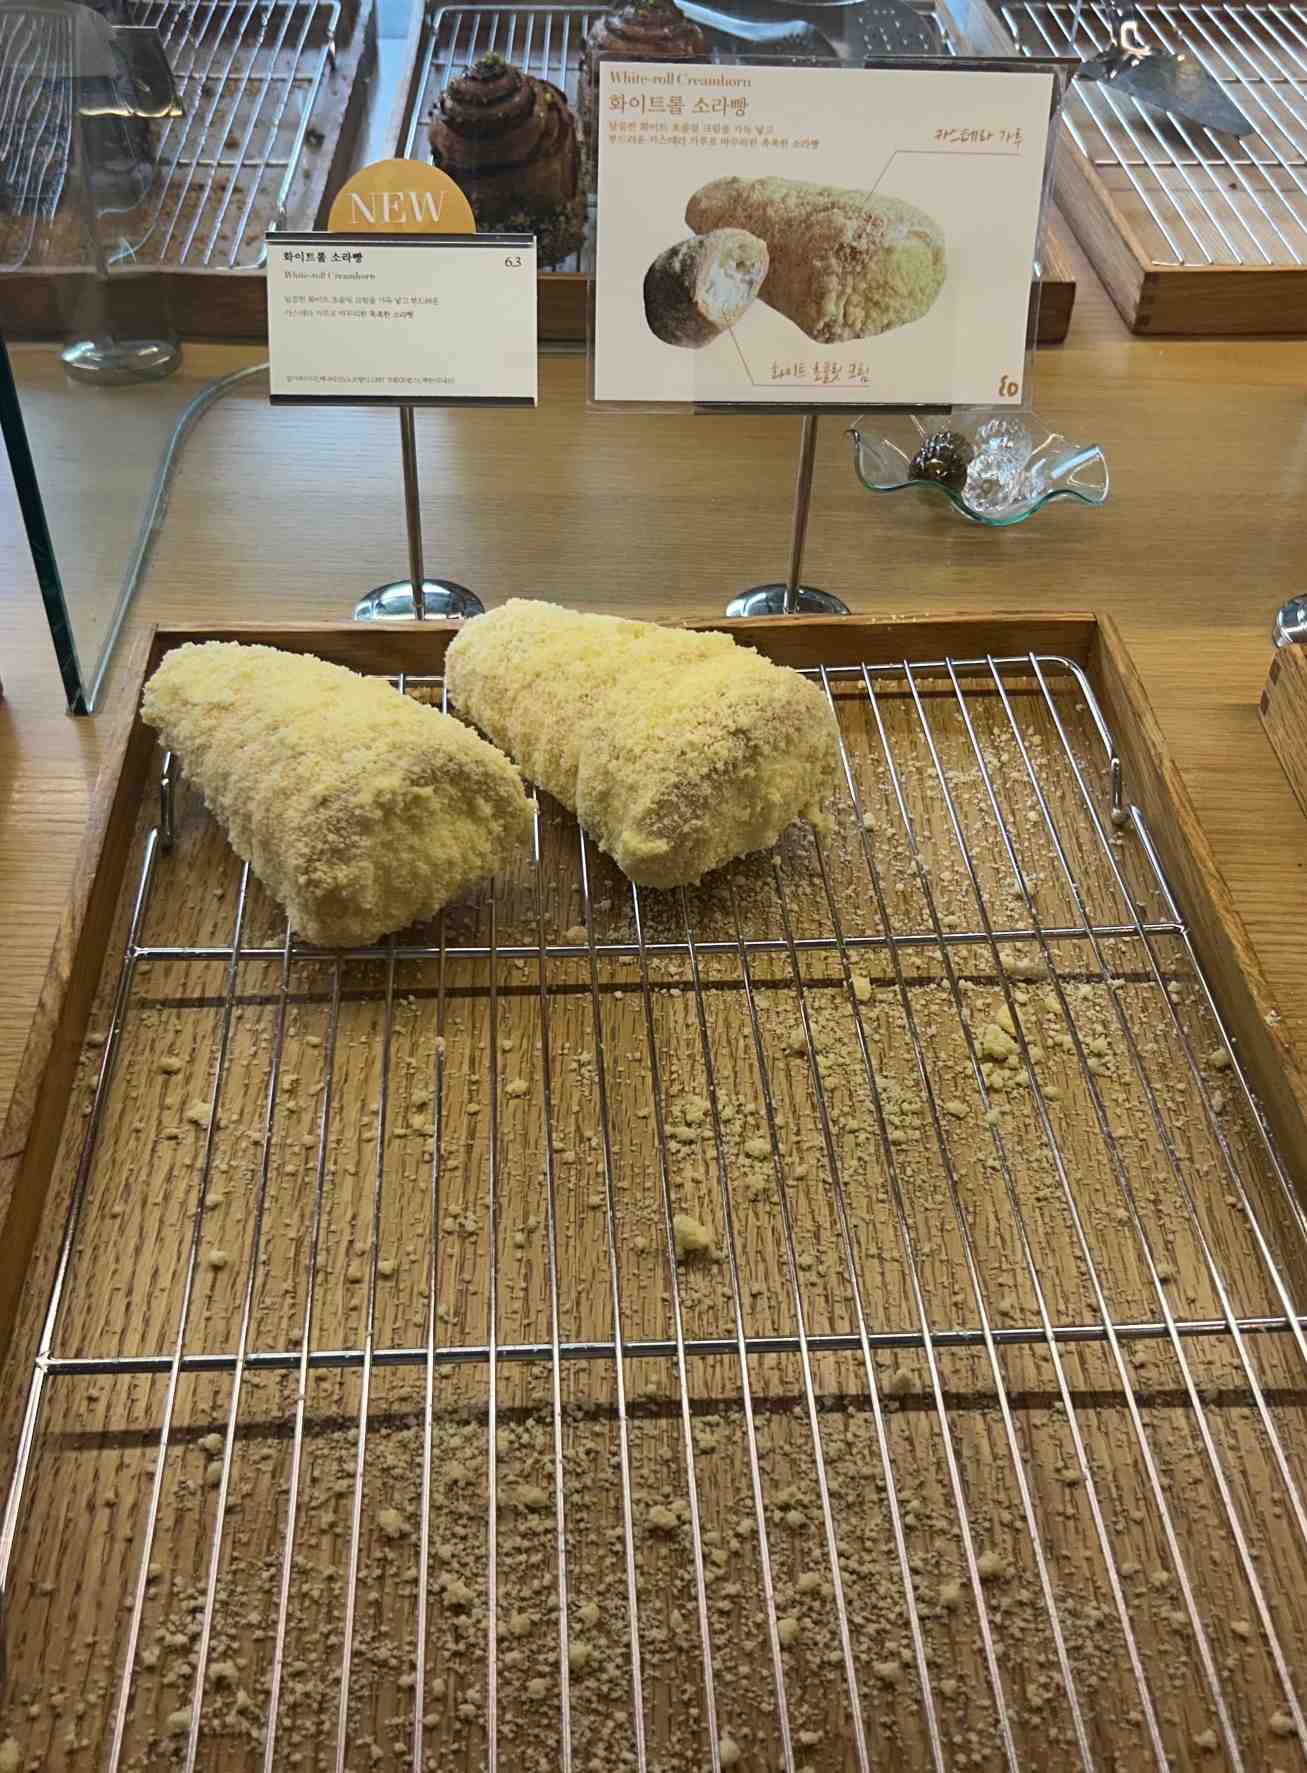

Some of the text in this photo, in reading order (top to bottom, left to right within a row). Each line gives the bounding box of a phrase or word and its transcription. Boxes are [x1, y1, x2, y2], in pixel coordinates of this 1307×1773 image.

[608, 71, 752, 88] White-roll Creamhorn
[608, 92, 750, 117] 화이트롤 소라빵
[934, 127, 1023, 152] 카스테라 가루
[351, 191, 448, 224] NEW
[283, 250, 363, 263] 화이트롤 소라빵
[770, 360, 806, 380] 화이트
[847, 360, 871, 384] 크림
